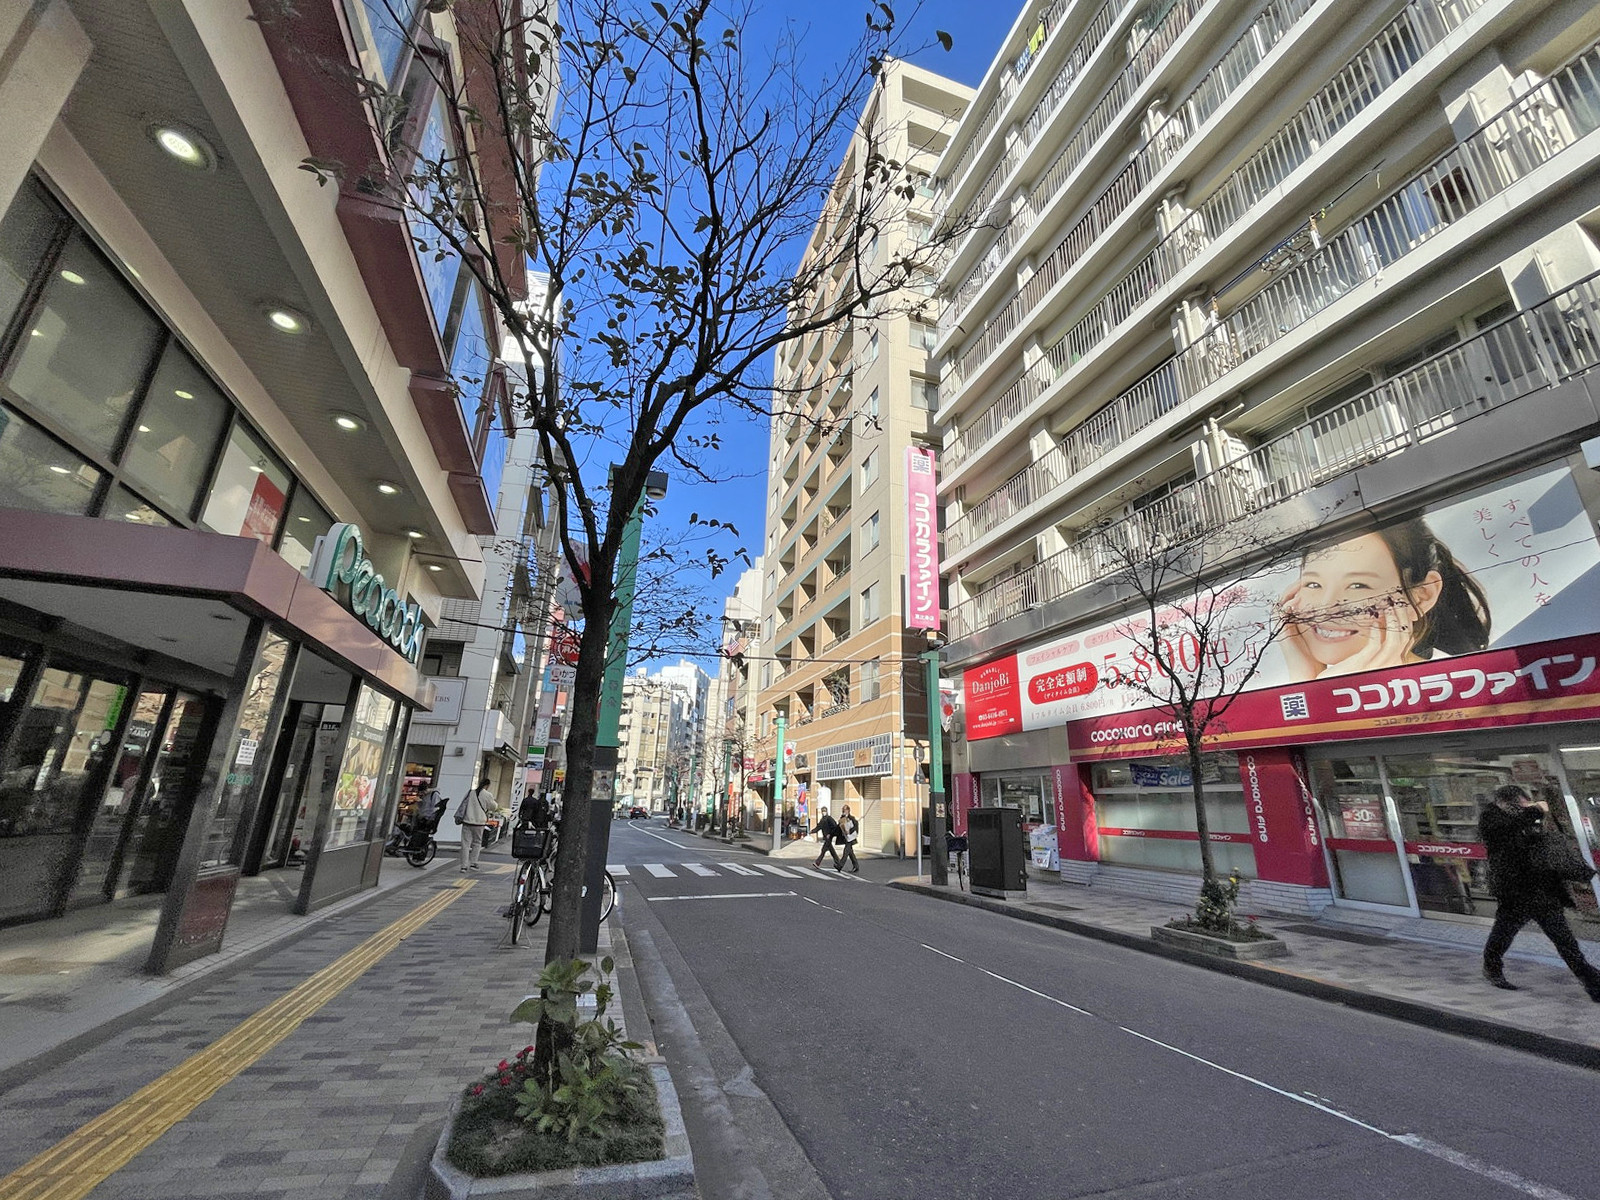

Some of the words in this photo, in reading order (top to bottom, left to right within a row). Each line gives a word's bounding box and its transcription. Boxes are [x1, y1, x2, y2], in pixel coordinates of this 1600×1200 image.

[914, 492, 933, 612] ココカラファイン
[1473, 507, 1499, 557] 美しく
[1502, 499, 1551, 607] すべての人を
[326, 523, 425, 664] Peacock
[972, 672, 1010, 694] DanjoBi
[1335, 655, 1596, 714] ココカラファイン
[1283, 696, 1307, 718] 薬
[1090, 723, 1152, 743] cocokara
[1154, 719, 1185, 735] fine
[1056, 769, 1065, 811] cocokara
[1160, 771, 1190, 786] Sale
[1246, 755, 1263, 814] cocokara
[1255, 815, 1269, 843] fine
[1307, 816, 1318, 846] fine
[1417, 844, 1472, 855] ココカラファイン
